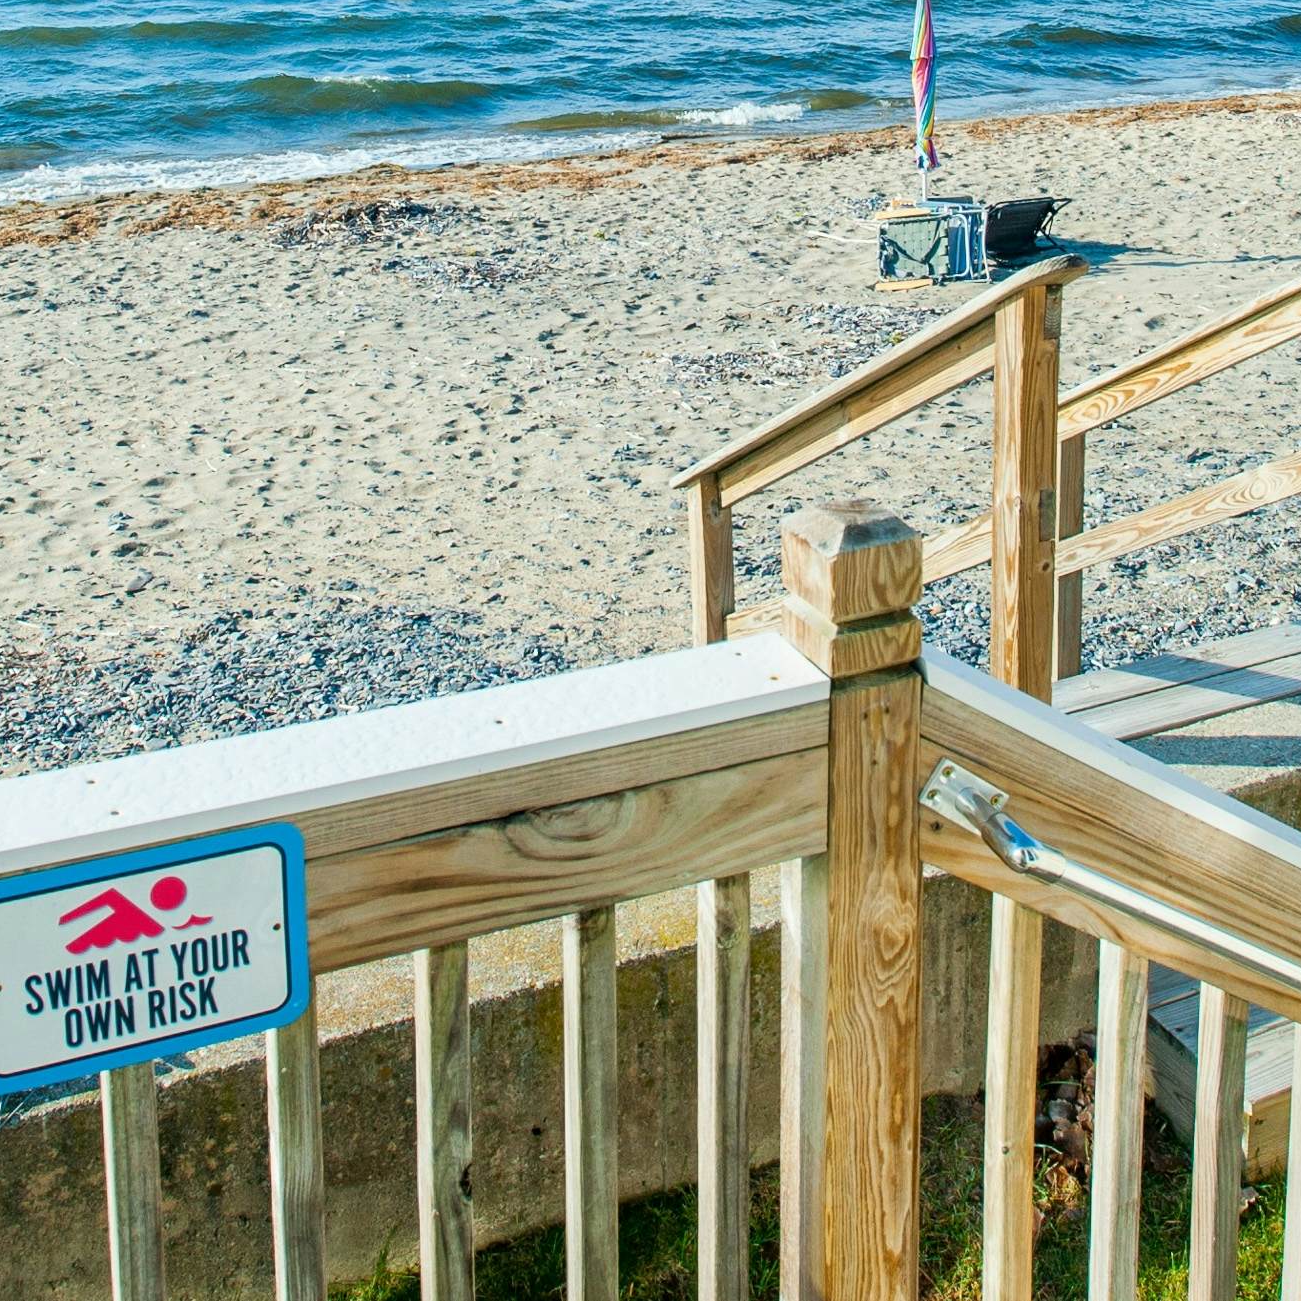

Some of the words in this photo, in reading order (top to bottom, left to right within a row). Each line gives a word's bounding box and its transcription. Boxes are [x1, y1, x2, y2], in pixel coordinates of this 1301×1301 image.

[25, 959, 110, 1015] SWIM
[124, 948, 160, 993] AT
[170, 929, 250, 981] YOUR
[64, 995, 136, 1048] OWN
[148, 976, 219, 1029] RISK
